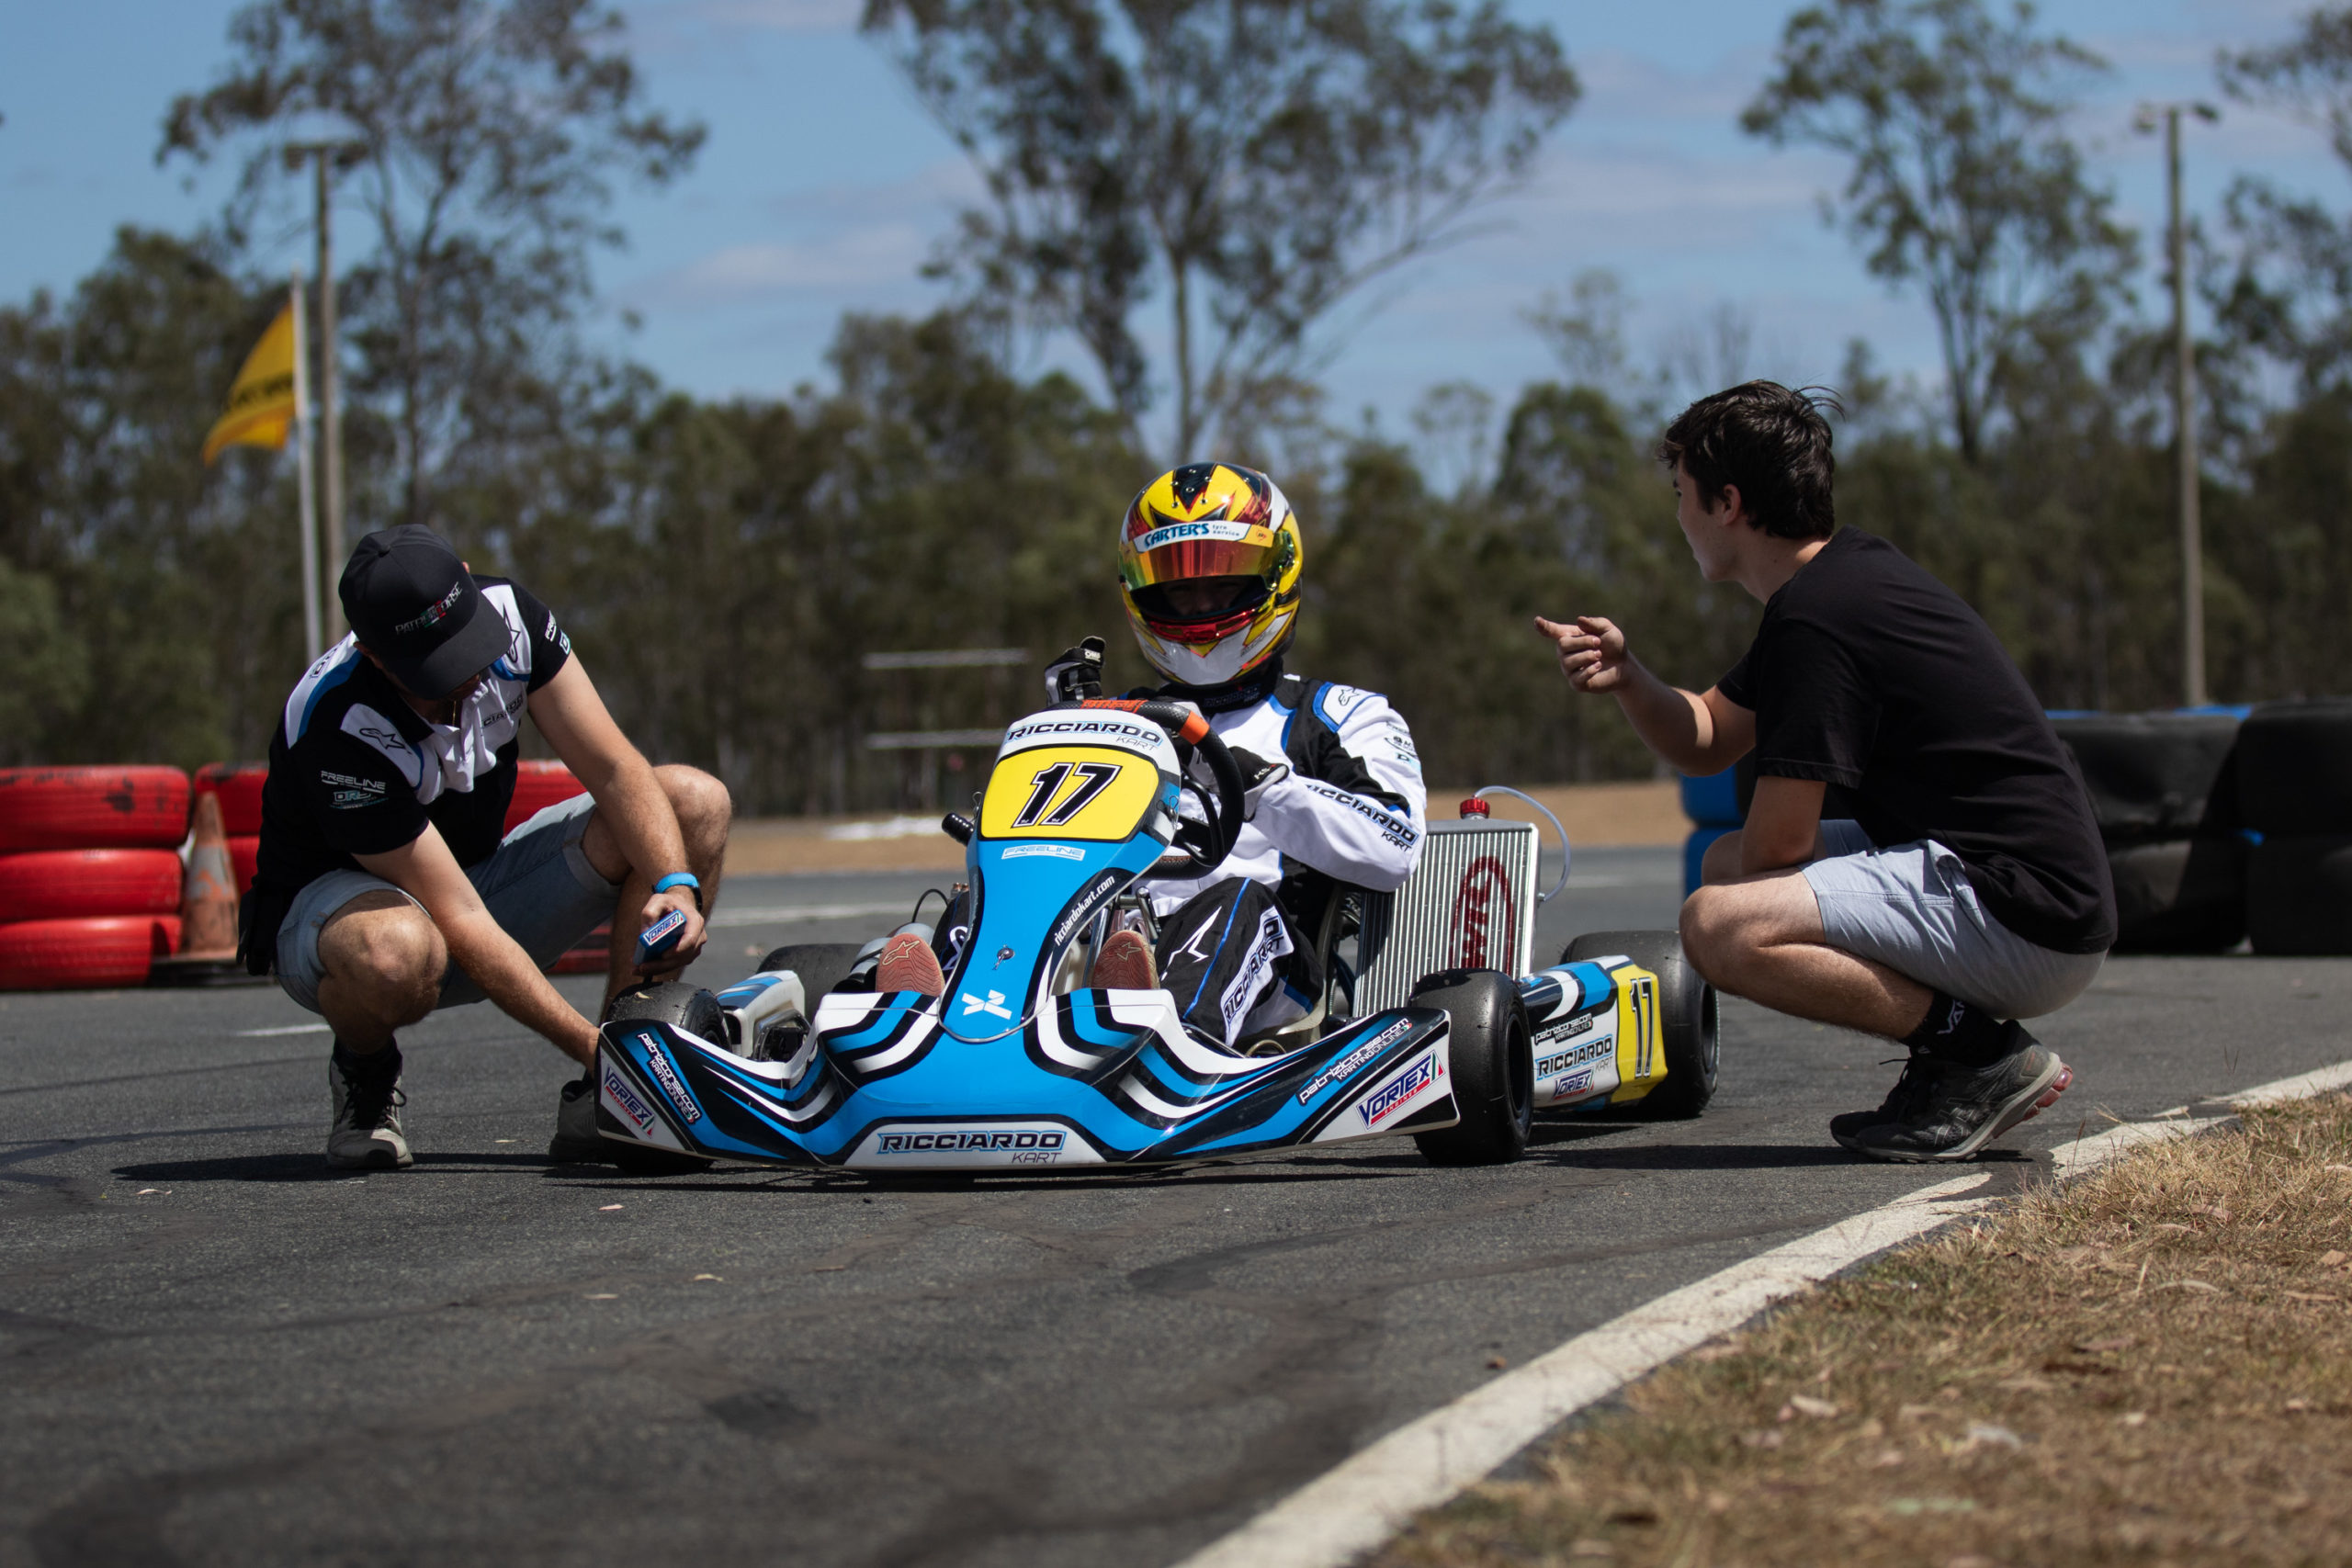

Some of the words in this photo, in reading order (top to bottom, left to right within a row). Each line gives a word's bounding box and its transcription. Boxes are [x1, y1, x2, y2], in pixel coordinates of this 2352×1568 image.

[1143, 523, 1211, 548] CARTER'S
[1007, 722, 1161, 745] RICCIARDO
[1115, 736, 1159, 751] KART
[321, 771, 386, 792] FREELINE
[1011, 762, 1123, 828] 17
[1306, 784, 1418, 844] ICCIARDO
[1004, 845, 1084, 857] FREELINE
[1381, 830, 1412, 852] KART
[1054, 875, 1115, 947] ricciardokart.com
[645, 912, 679, 942] VORTEX
[1630, 977, 1653, 1078] 17
[1537, 1036, 1613, 1077] RICCIARDO
[1595, 1056, 1613, 1072] KART
[605, 1066, 653, 1122] VORTEX
[1357, 1055, 1431, 1126] VORTEX
[1554, 1069, 1592, 1097] VORTEX
[882, 1132, 1065, 1152] RICCIARDO
[1012, 1152, 1062, 1164] KART
